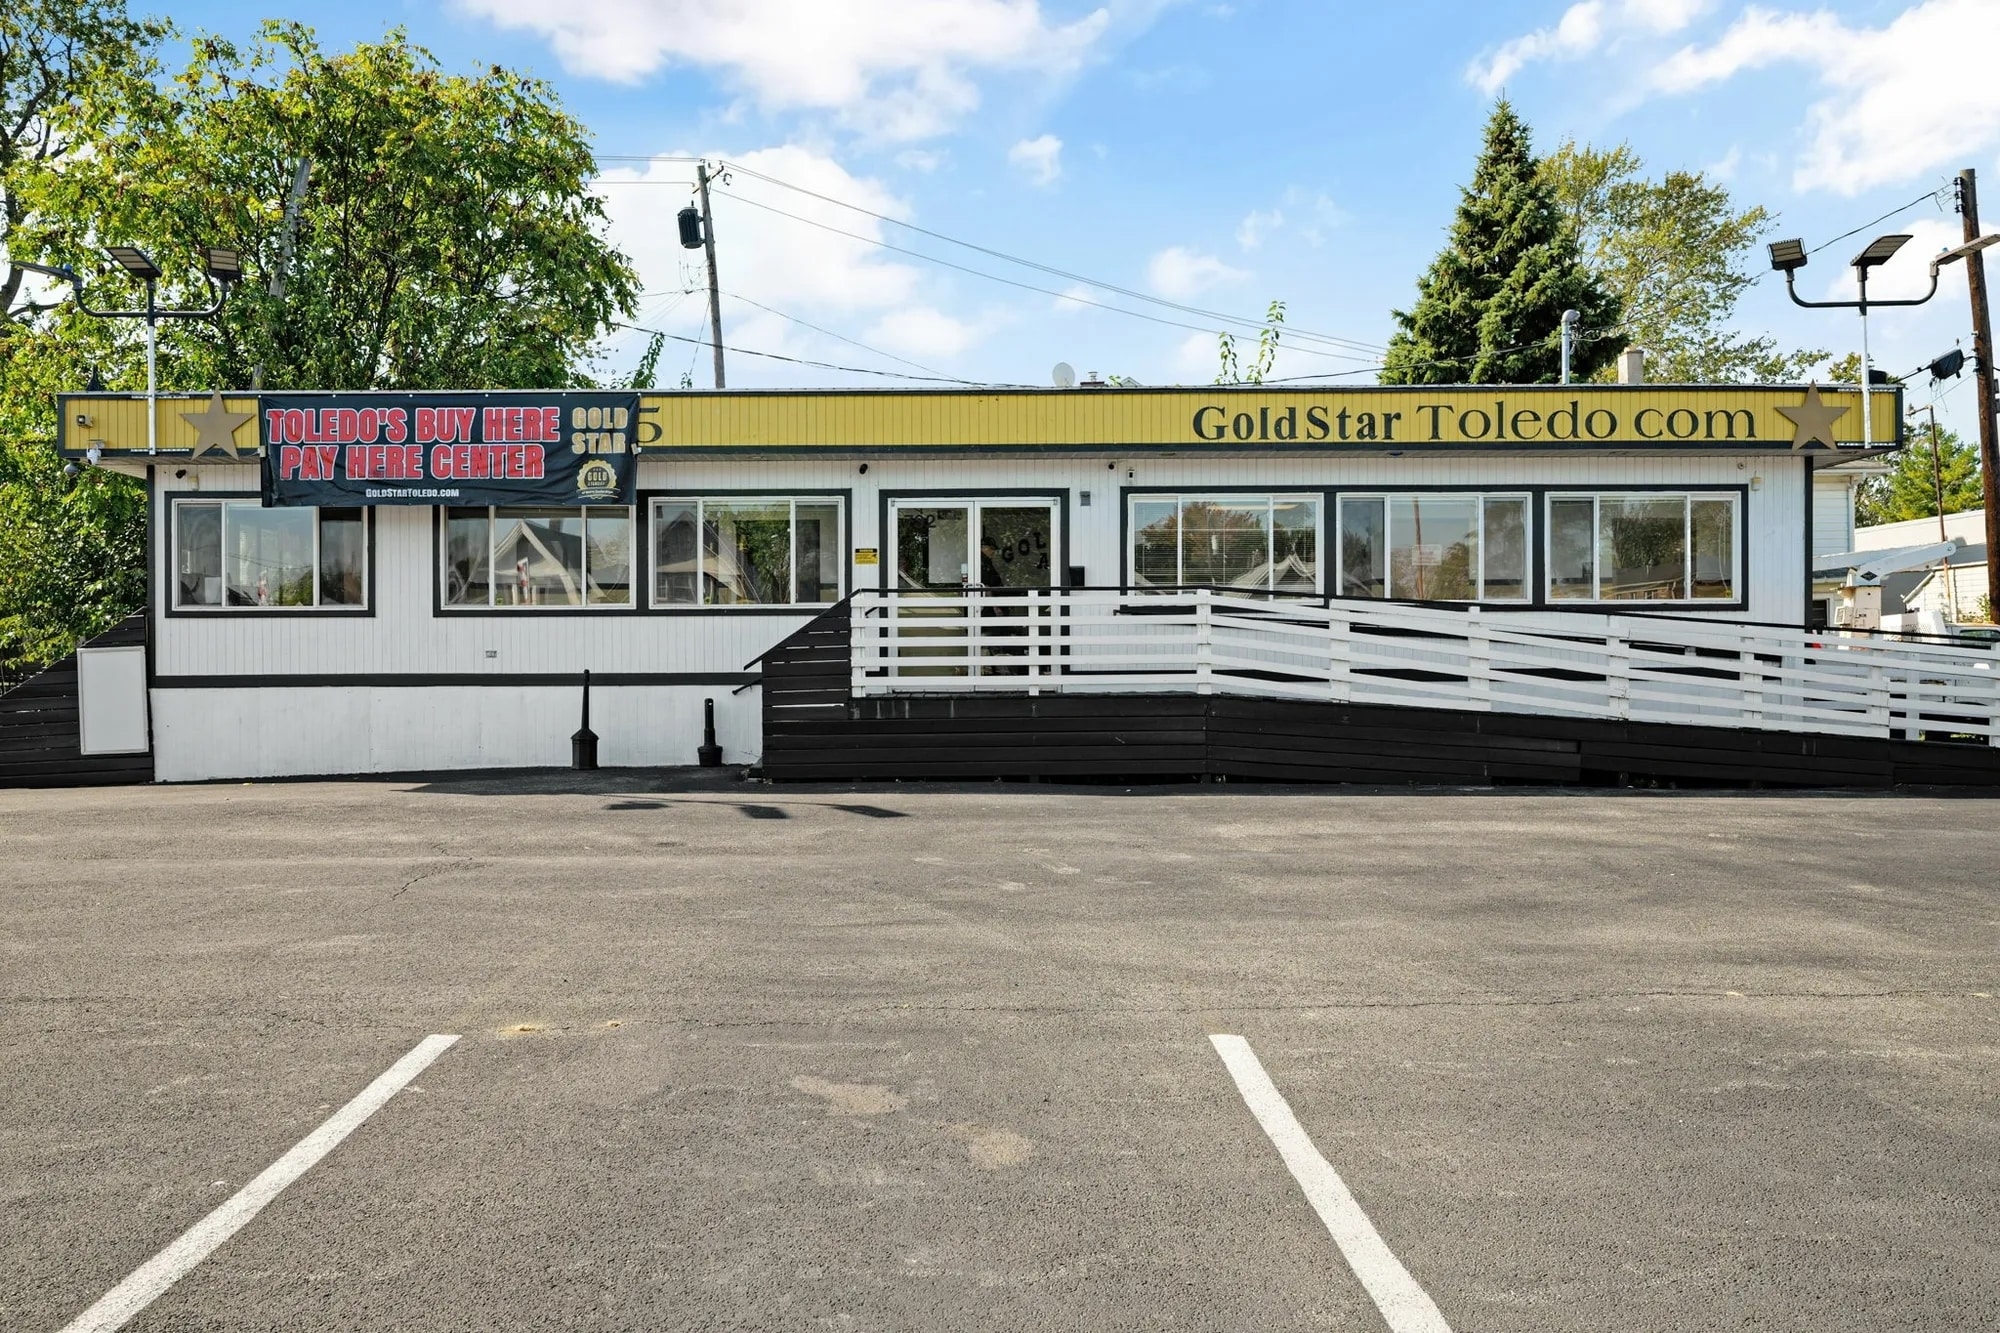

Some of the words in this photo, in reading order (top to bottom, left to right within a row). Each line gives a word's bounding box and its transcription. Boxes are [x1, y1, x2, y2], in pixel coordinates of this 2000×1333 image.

[266, 407, 407, 443] TOLEDO'S
[415, 407, 476, 443] BUY
[483, 407, 560, 442] HERE
[572, 407, 628, 429] GOLD
[1416, 401, 1617, 439] Toledo
[1634, 408, 1757, 439] com
[572, 432, 626, 454] STAR
[281, 445, 339, 480] PAY
[346, 445, 423, 479] HERE
[431, 444, 545, 479] CENTER
